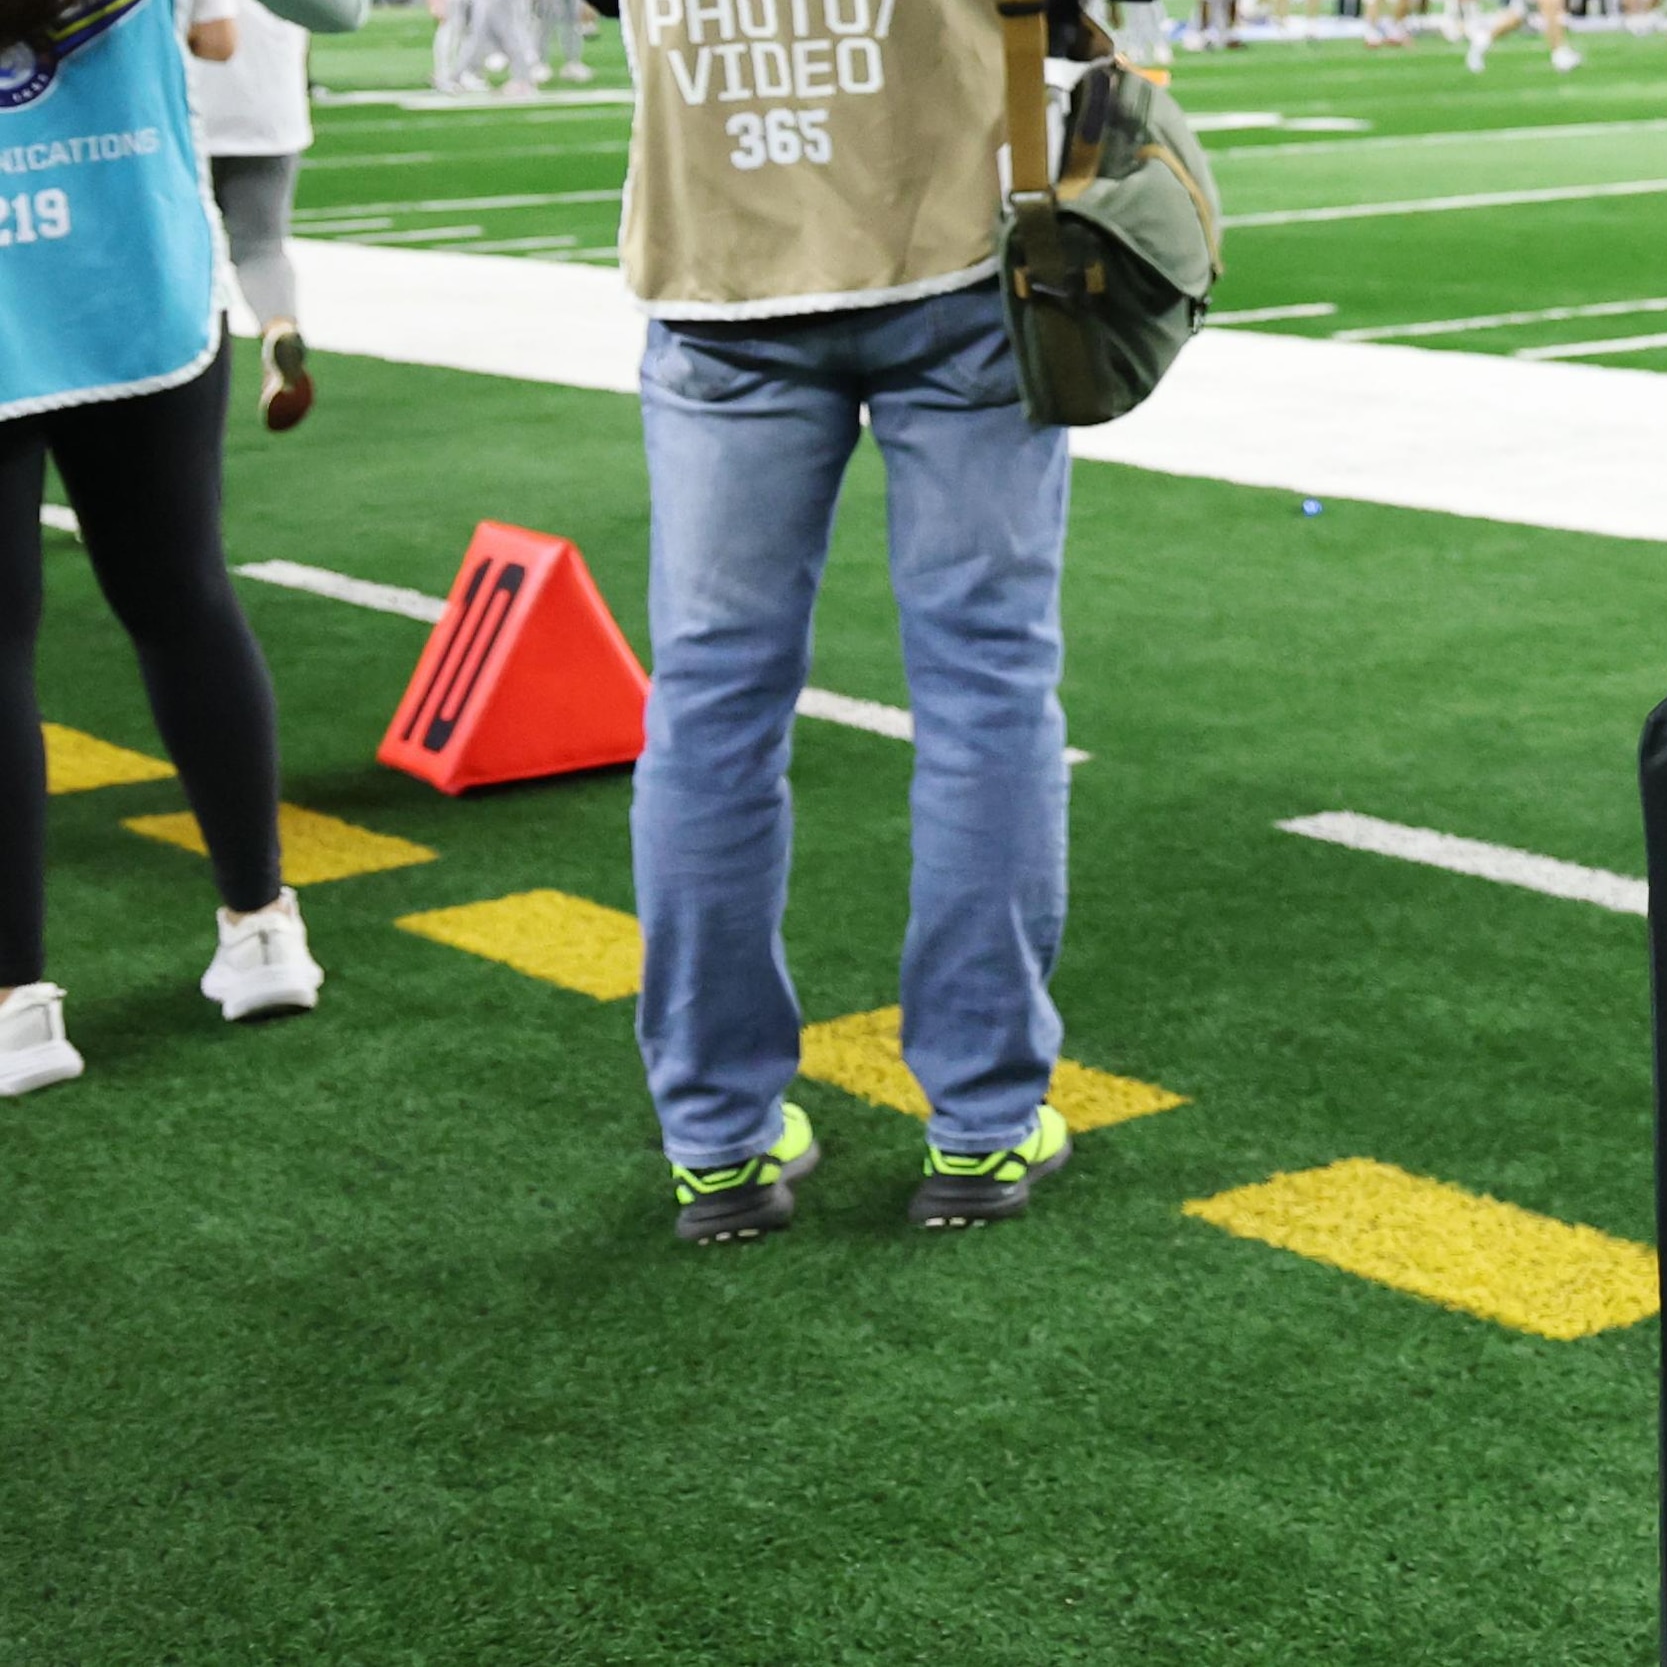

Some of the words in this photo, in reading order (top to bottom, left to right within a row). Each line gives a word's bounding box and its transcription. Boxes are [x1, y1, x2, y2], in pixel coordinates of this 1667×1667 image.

[667, 36, 884, 105] VIDEO
[726, 107, 833, 170] 365
[403, 557, 526, 752] 10
